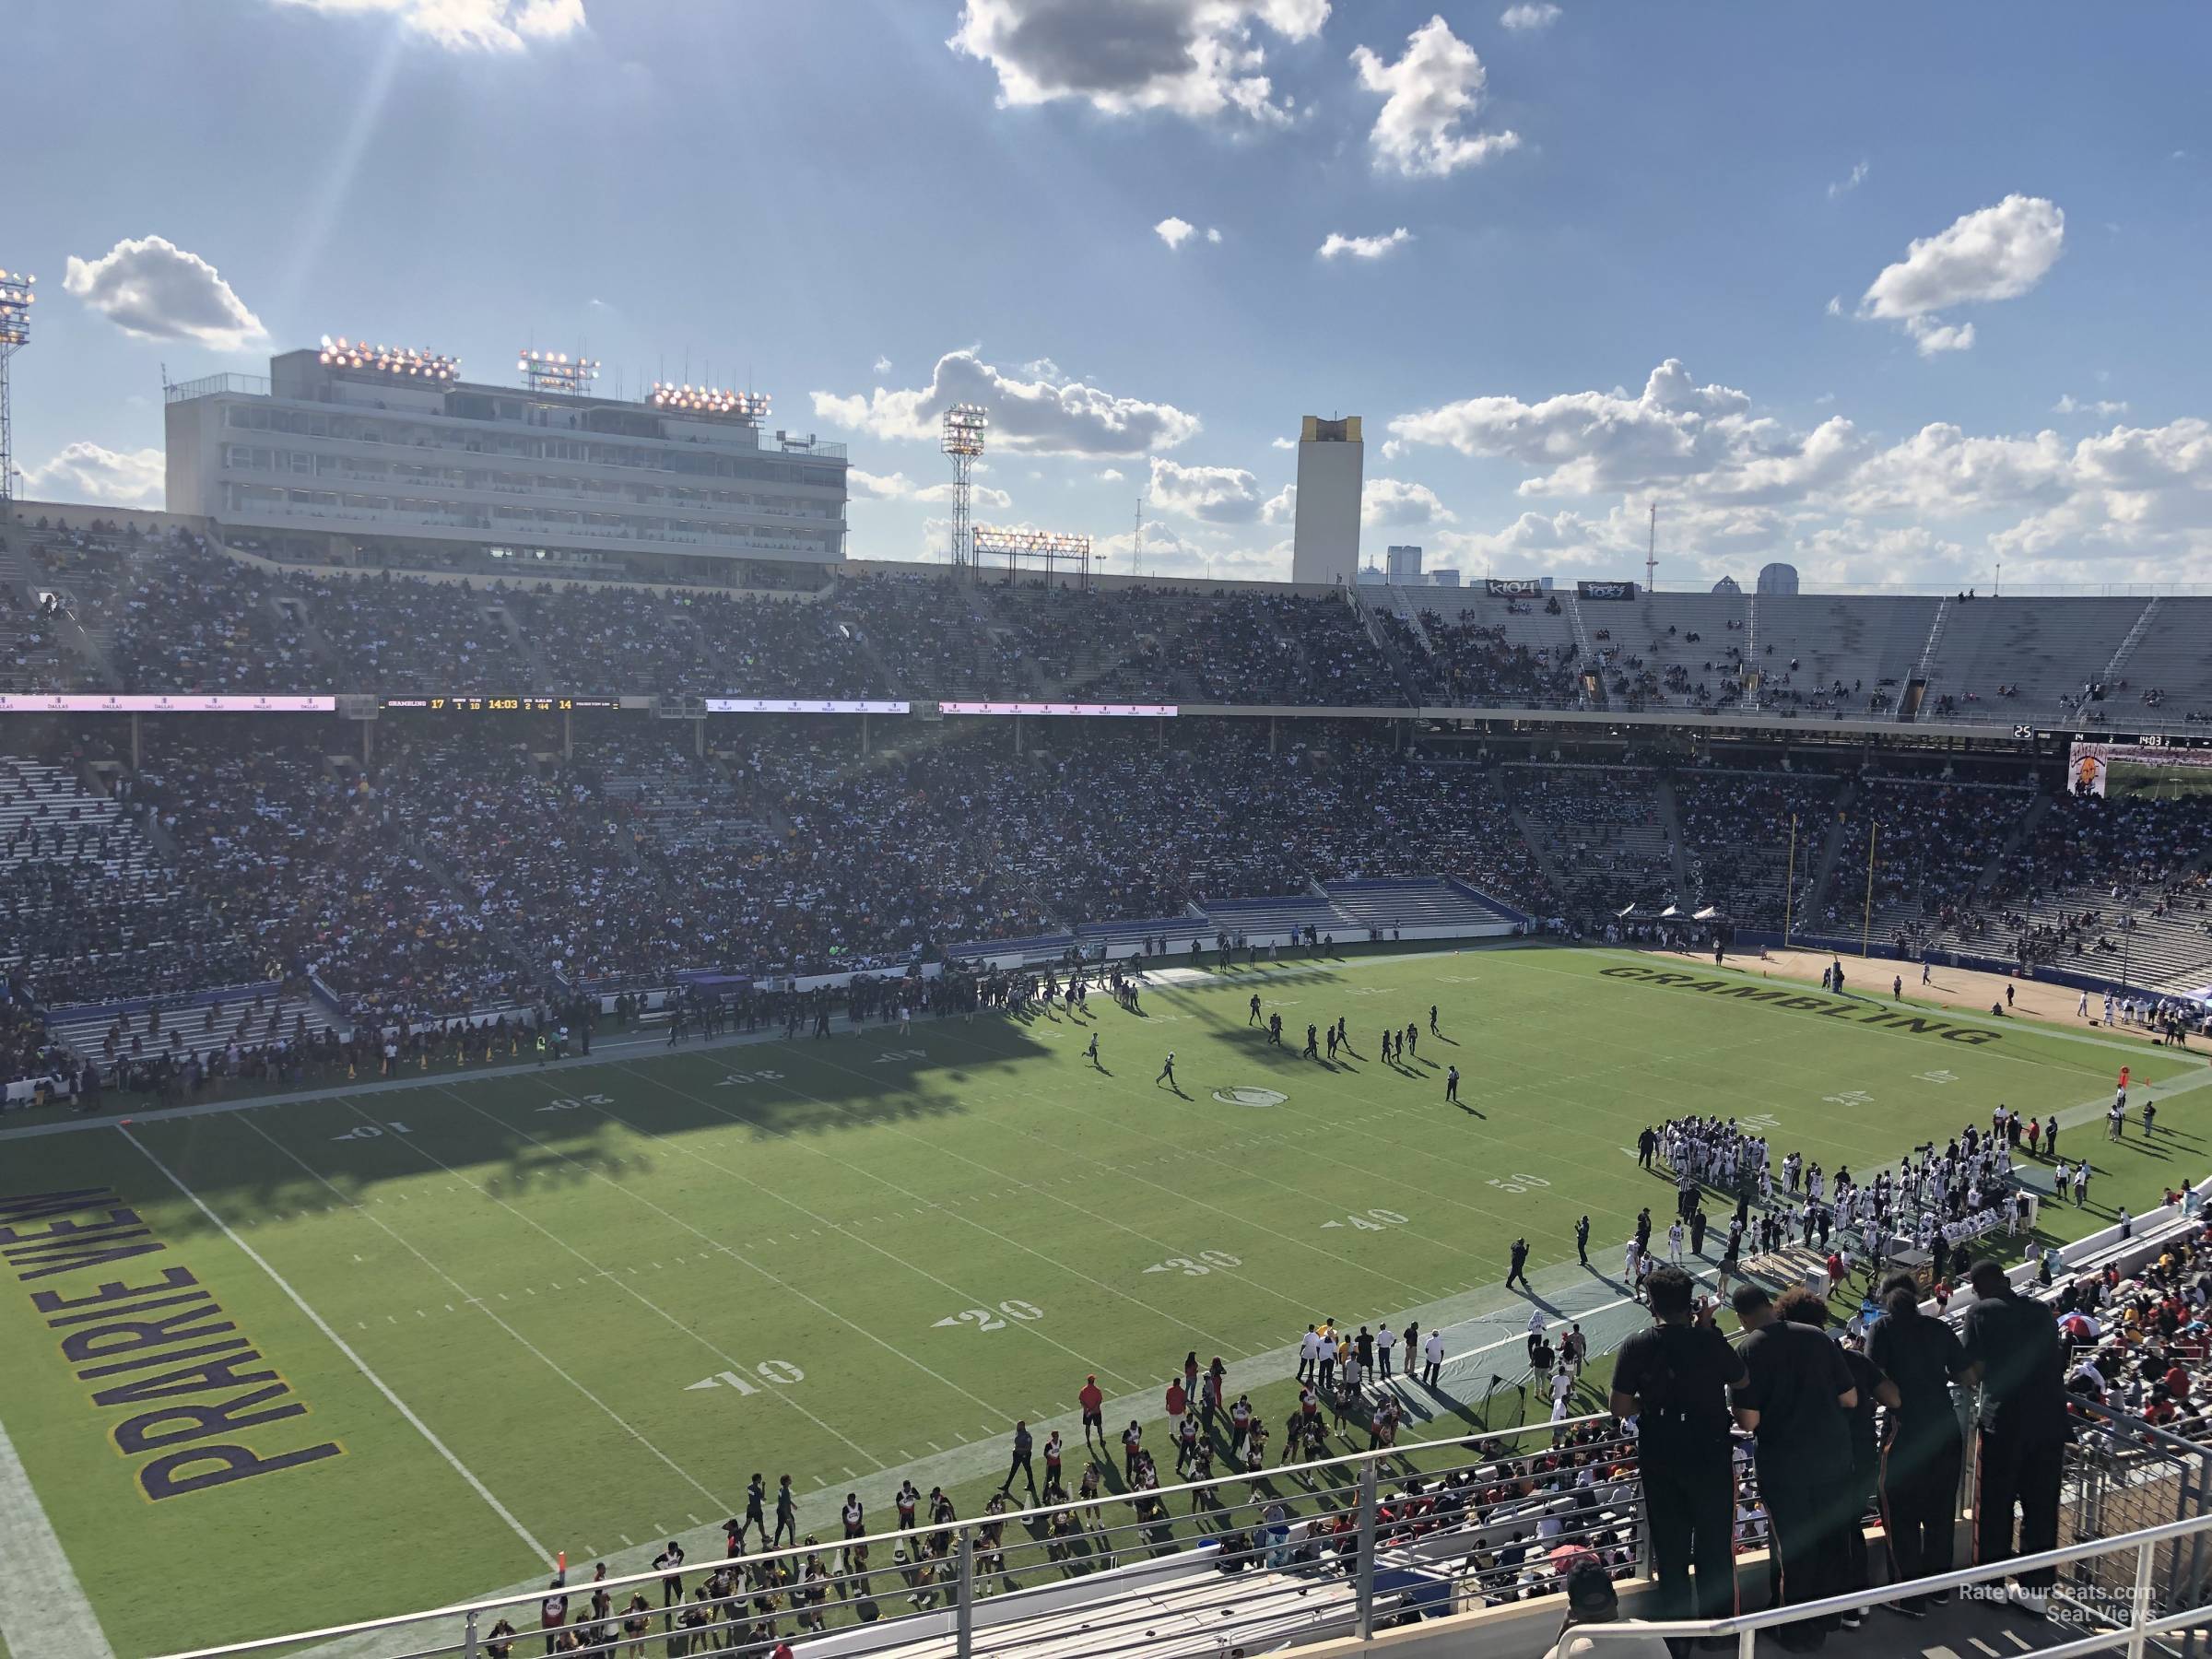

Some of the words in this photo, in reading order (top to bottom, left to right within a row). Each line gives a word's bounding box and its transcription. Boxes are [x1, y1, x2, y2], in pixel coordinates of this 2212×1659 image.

[430, 699, 444, 709] 17
[488, 700, 518, 709] 14:03
[559, 700, 571, 709] 14
[2014, 725, 2031, 738] 25
[2075, 733, 2084, 741] 14
[2139, 735, 2161, 746] 14:03
[1599, 965, 2003, 1045] GRAMBLING
[726, 1070, 785, 1084] 30
[550, 1093, 616, 1109] 20
[351, 1121, 414, 1138] 10
[1485, 1172, 1551, 1194] 50
[1347, 1207, 1409, 1232] 40
[0, 1185, 167, 1281] VIEW
[1167, 1248, 1242, 1277] 30
[956, 1299, 1044, 1332] 20
[28, 1265, 348, 1504] PRAIRIE
[716, 1359, 805, 1397] 10
